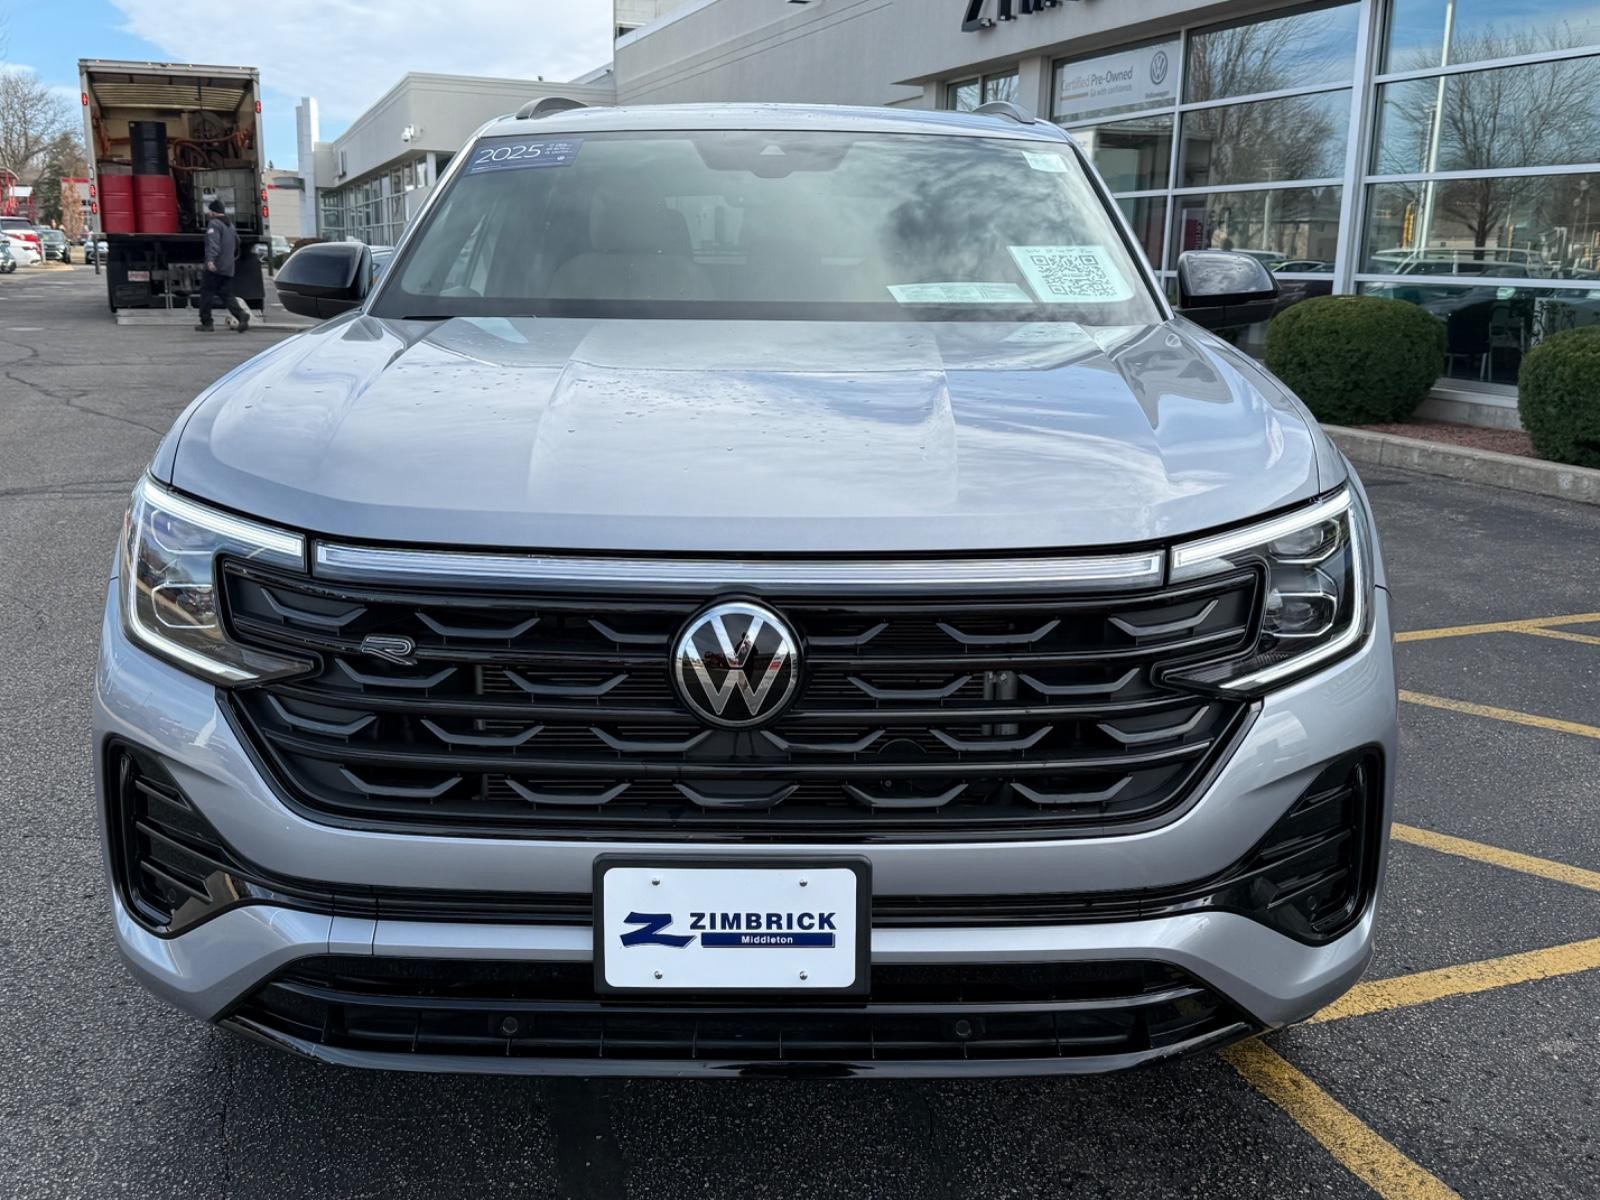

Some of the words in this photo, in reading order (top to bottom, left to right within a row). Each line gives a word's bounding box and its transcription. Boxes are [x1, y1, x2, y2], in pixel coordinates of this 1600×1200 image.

[1091, 66, 1133, 86] Pre-Owned
[475, 144, 544, 164] 2025
[689, 912, 837, 931] ZIMBRICK
[741, 935, 793, 944] Middleton
